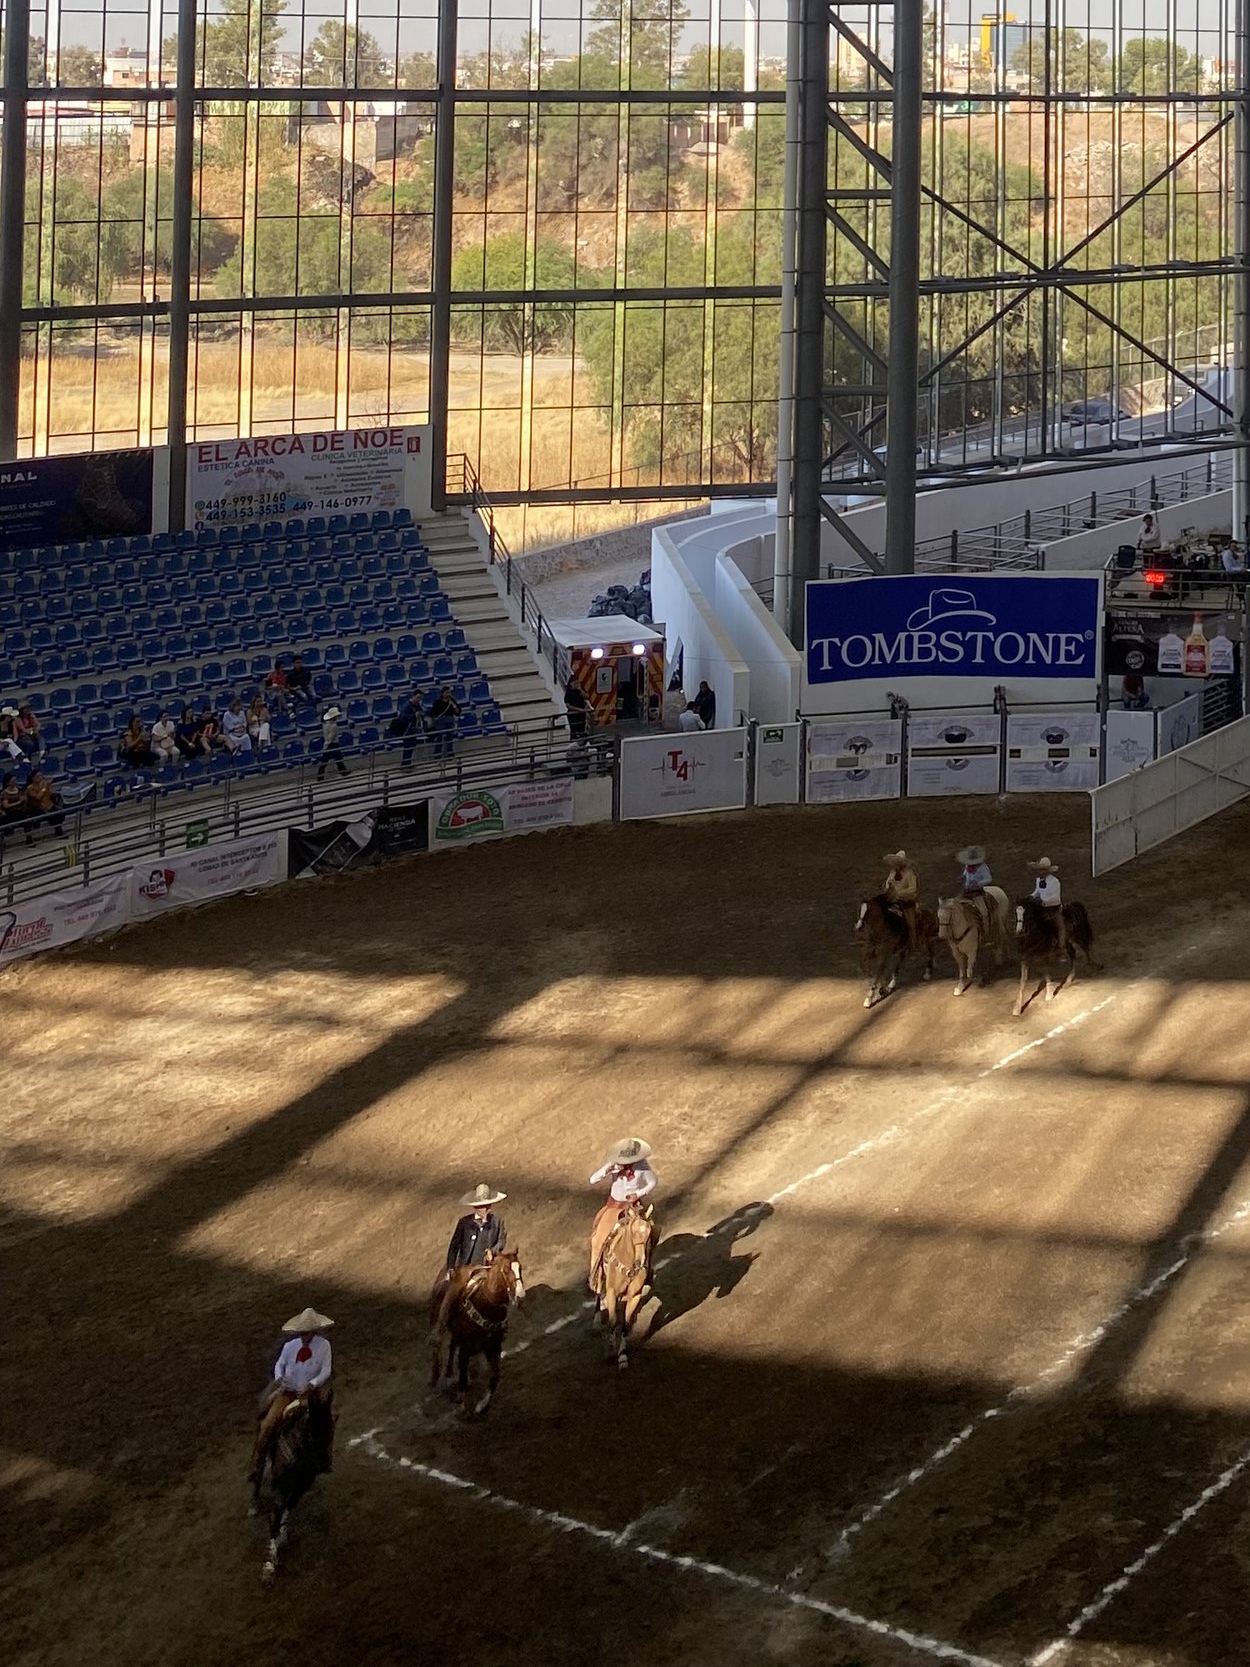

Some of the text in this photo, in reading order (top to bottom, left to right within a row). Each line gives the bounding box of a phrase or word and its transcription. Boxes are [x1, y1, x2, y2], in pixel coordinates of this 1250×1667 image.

[198, 428, 404, 463] EL ARCA DE NOE
[311, 452, 345, 462] CLINICA
[346, 447, 403, 459] VETERINARIA
[198, 457, 275, 473] ESTETICA CANINA
[205, 492, 286, 510] 449-999-3160
[293, 495, 372, 511] 449-146-0977
[206, 503, 286, 521] 449-153-3535
[811, 631, 1085, 671] TOMBSTONE
